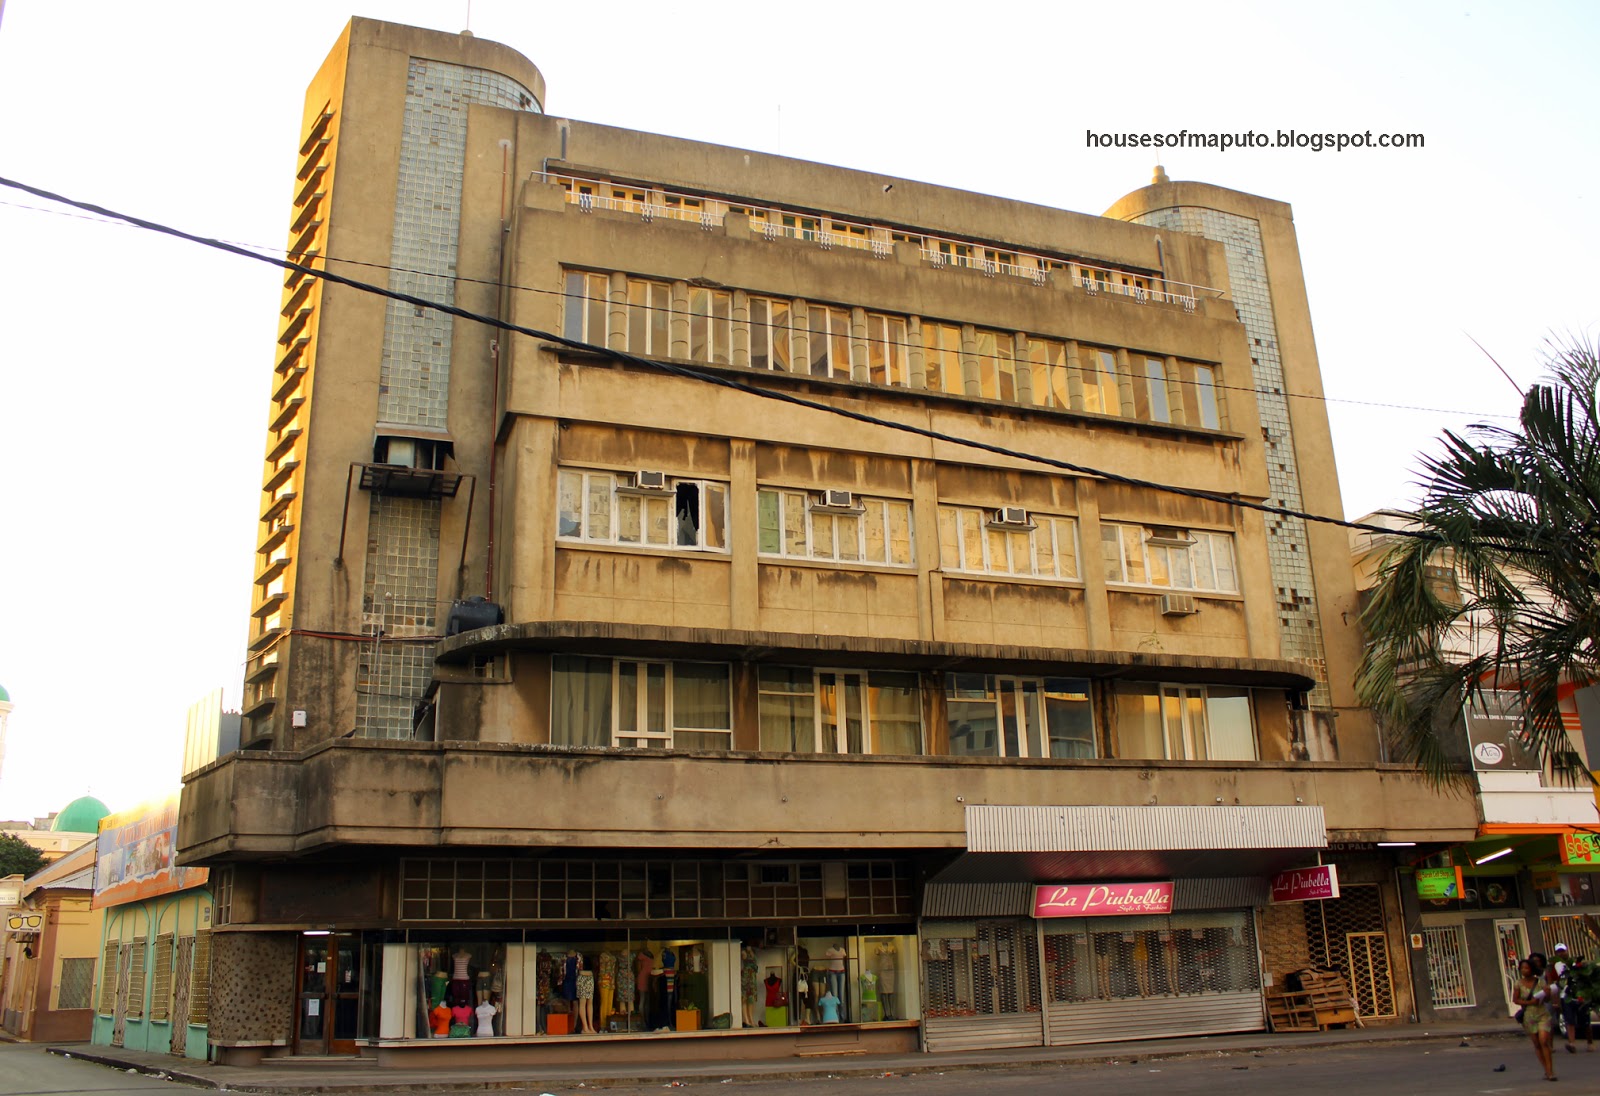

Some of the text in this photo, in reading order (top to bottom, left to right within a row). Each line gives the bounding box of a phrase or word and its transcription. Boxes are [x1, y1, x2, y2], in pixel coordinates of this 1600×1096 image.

[1274, 874, 1288, 892] La
[1039, 886, 1170, 912] La Piubella
[1117, 904, 1135, 913] Style
[1143, 903, 1168, 911] Fashion
